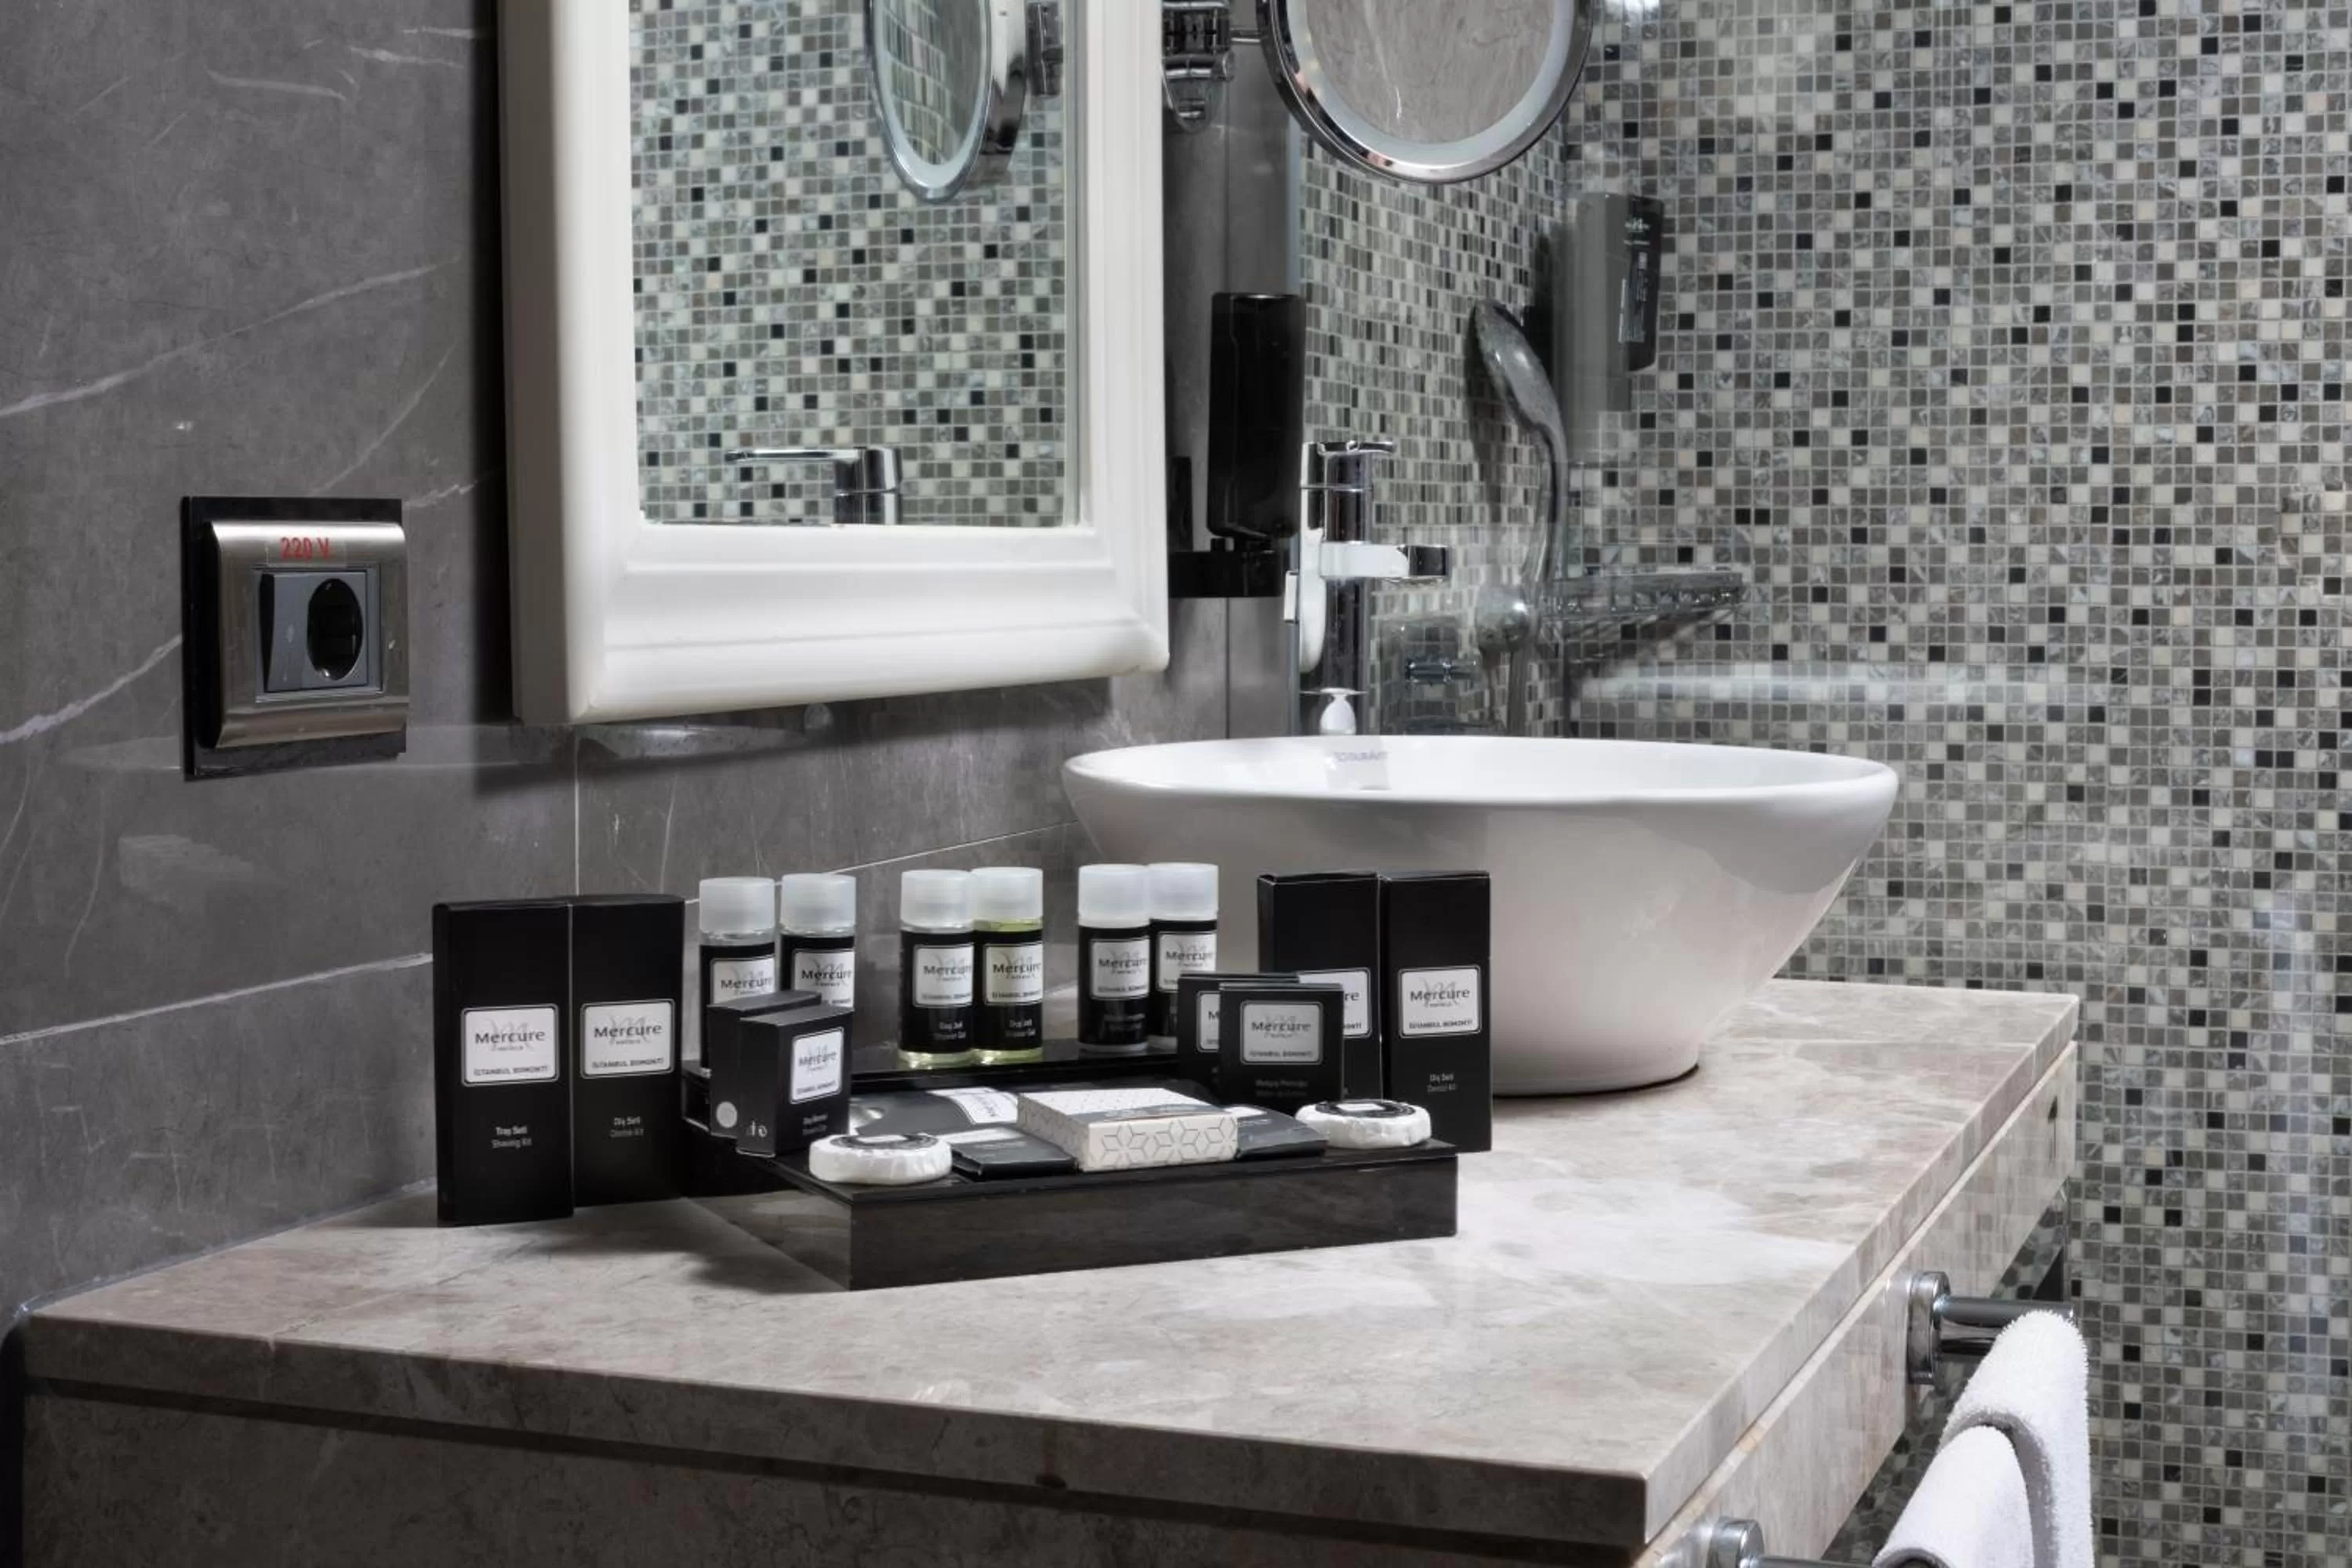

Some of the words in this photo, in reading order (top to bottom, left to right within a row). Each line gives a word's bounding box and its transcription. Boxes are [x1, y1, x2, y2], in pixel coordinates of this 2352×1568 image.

[281, 536, 313, 560] 220
[316, 536, 329, 559] V
[1410, 989, 1471, 1003] Mercure
[593, 1024, 662, 1039] Mercure
[1251, 1020, 1312, 1033] Mercure
[474, 1029, 546, 1045] Mercure
